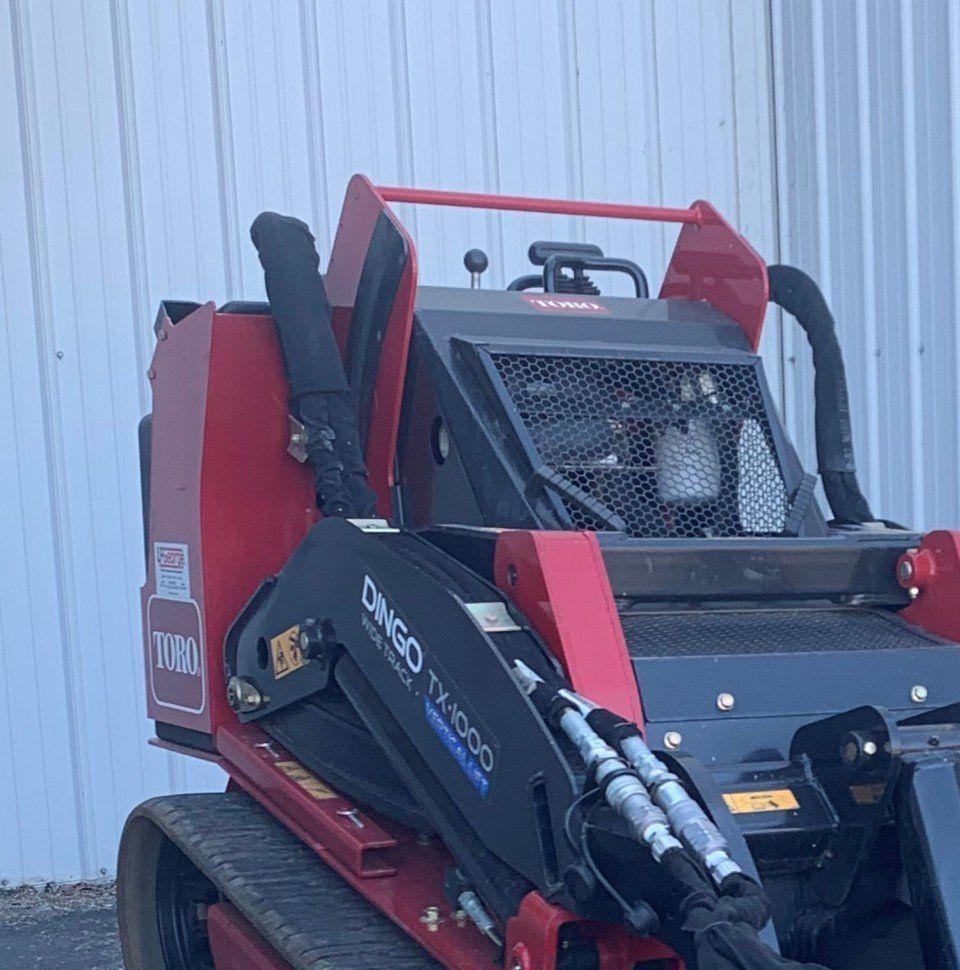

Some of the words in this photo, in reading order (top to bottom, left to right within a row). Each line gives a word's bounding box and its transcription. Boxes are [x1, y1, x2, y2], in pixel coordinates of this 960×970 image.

[530, 299, 601, 310] TORO
[362, 574, 423, 674] DINGO
[152, 631, 199, 676] TORO
